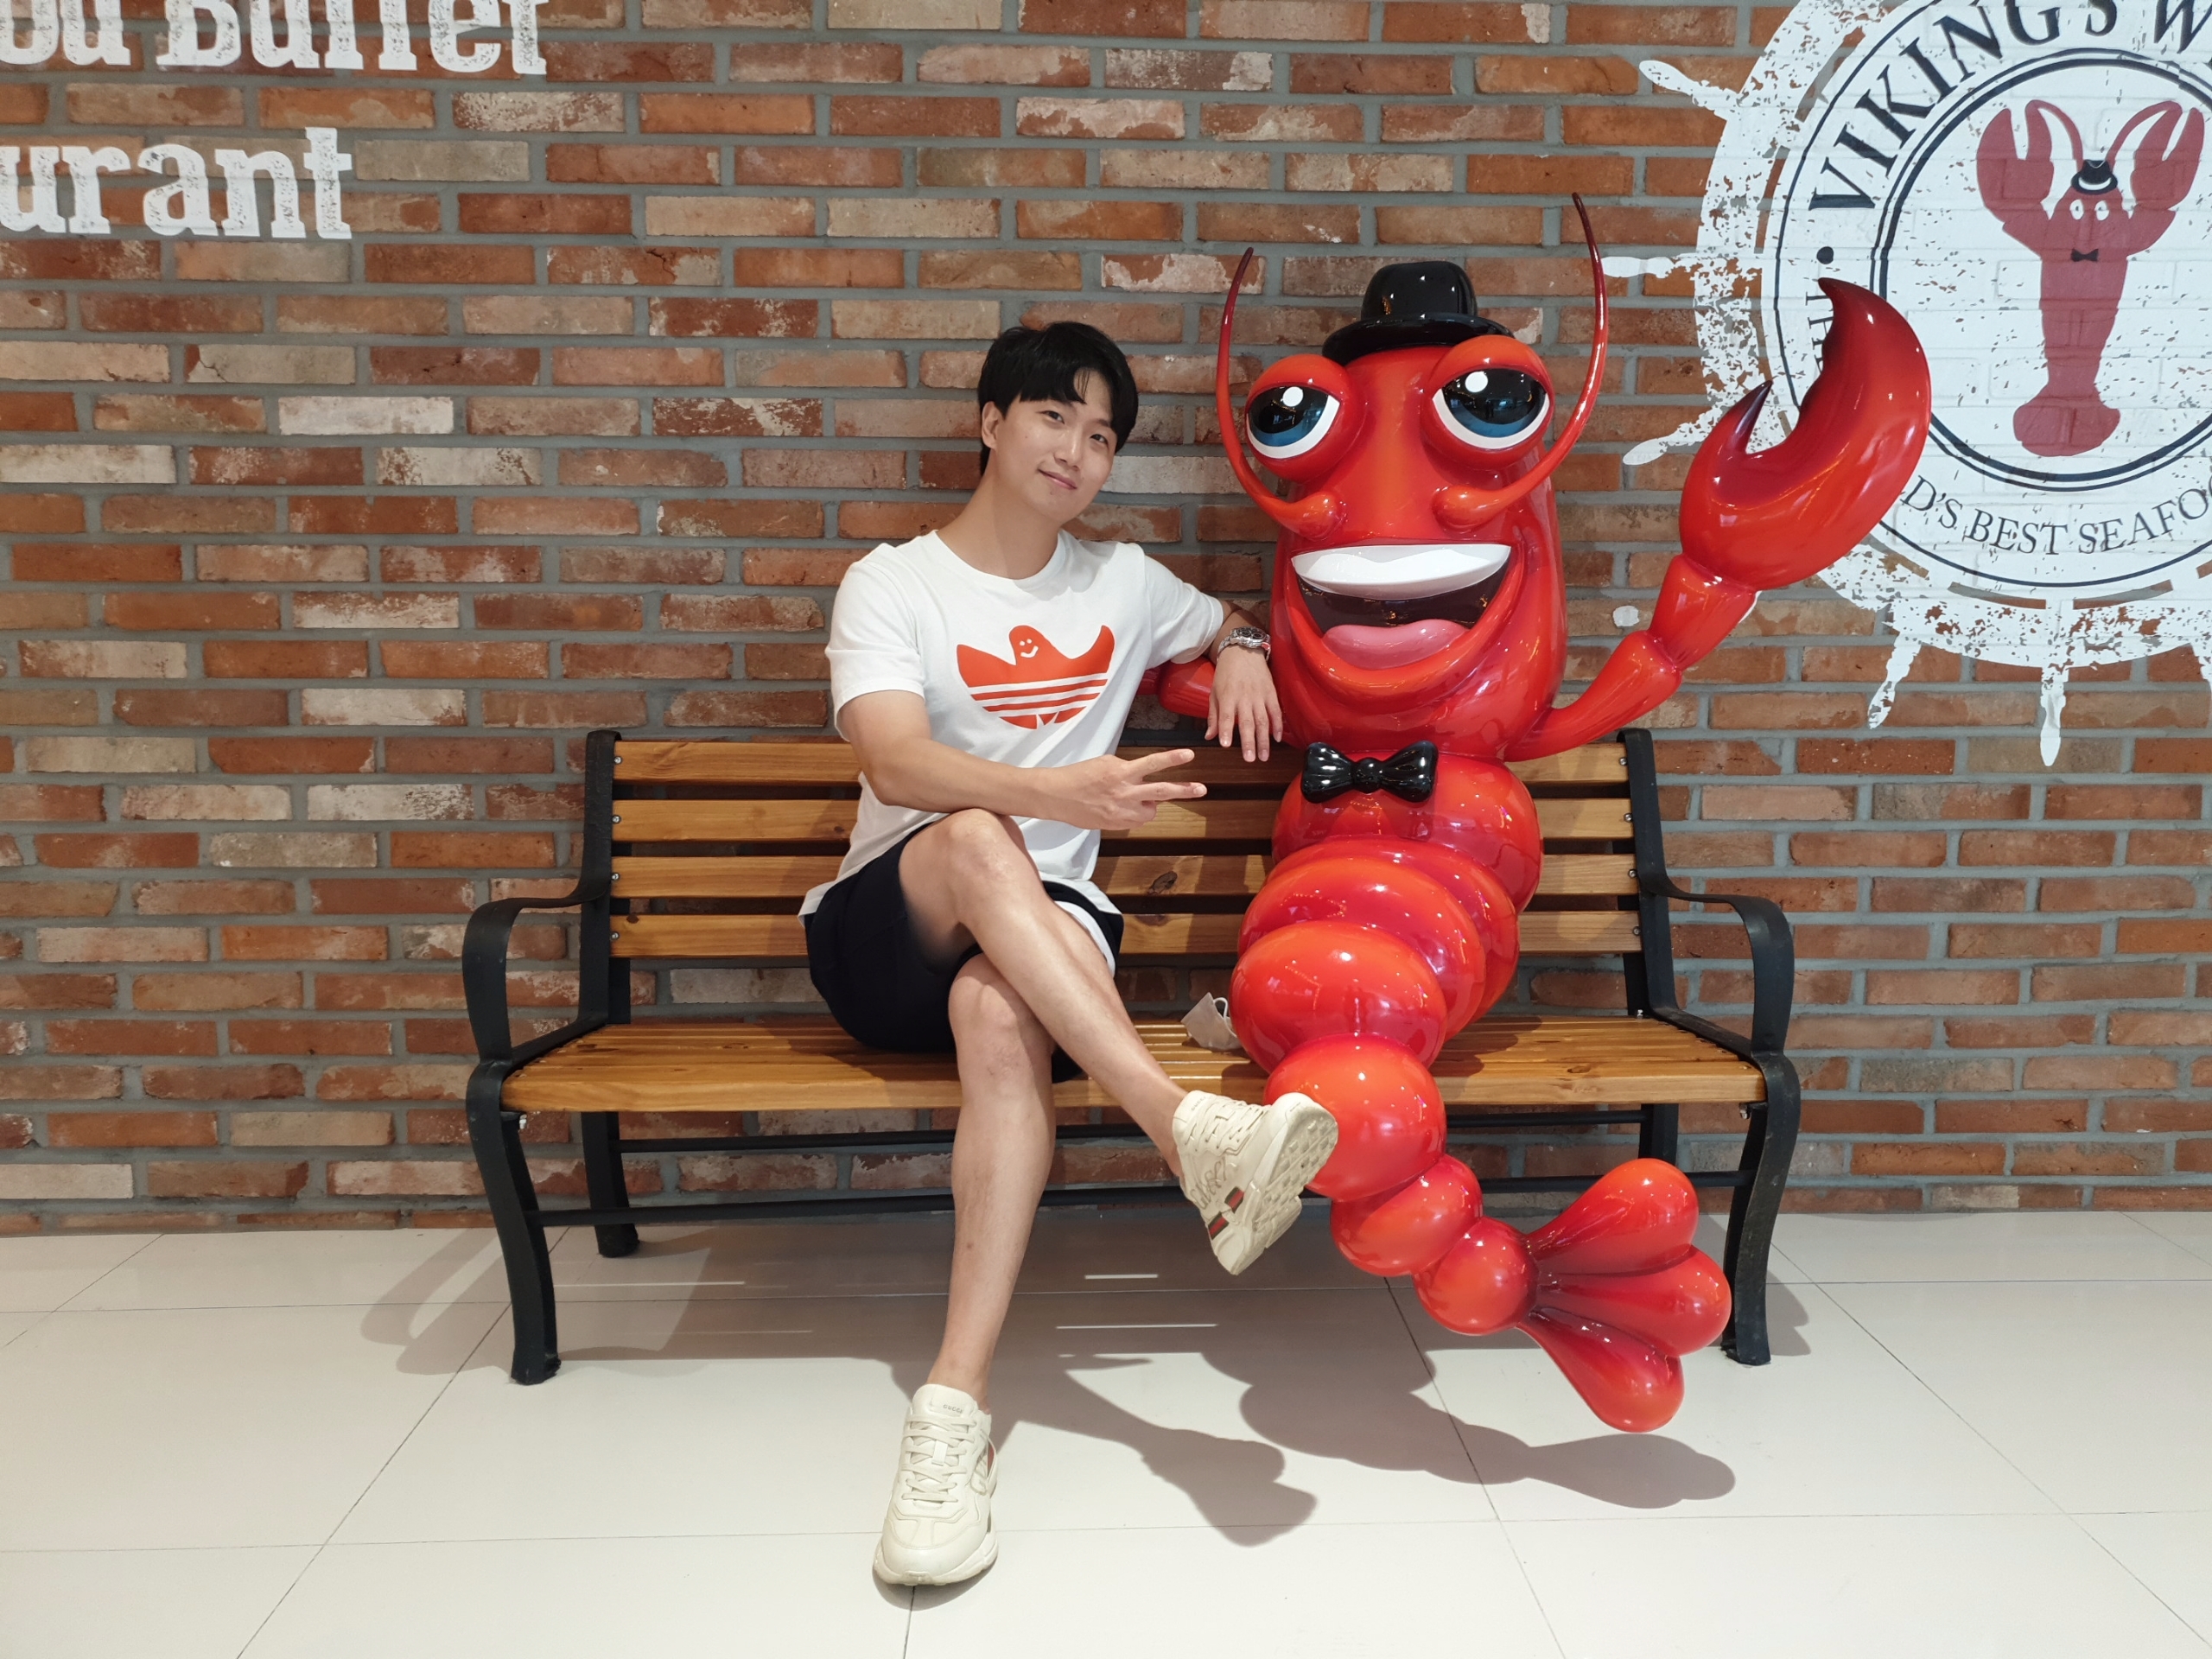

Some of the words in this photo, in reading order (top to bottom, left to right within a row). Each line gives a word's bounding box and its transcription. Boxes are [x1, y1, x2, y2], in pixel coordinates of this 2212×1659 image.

[0, 127, 353, 239] urant
[1964, 508, 2068, 555] BEST
[2078, 475, 2212, 554] SEAFO
